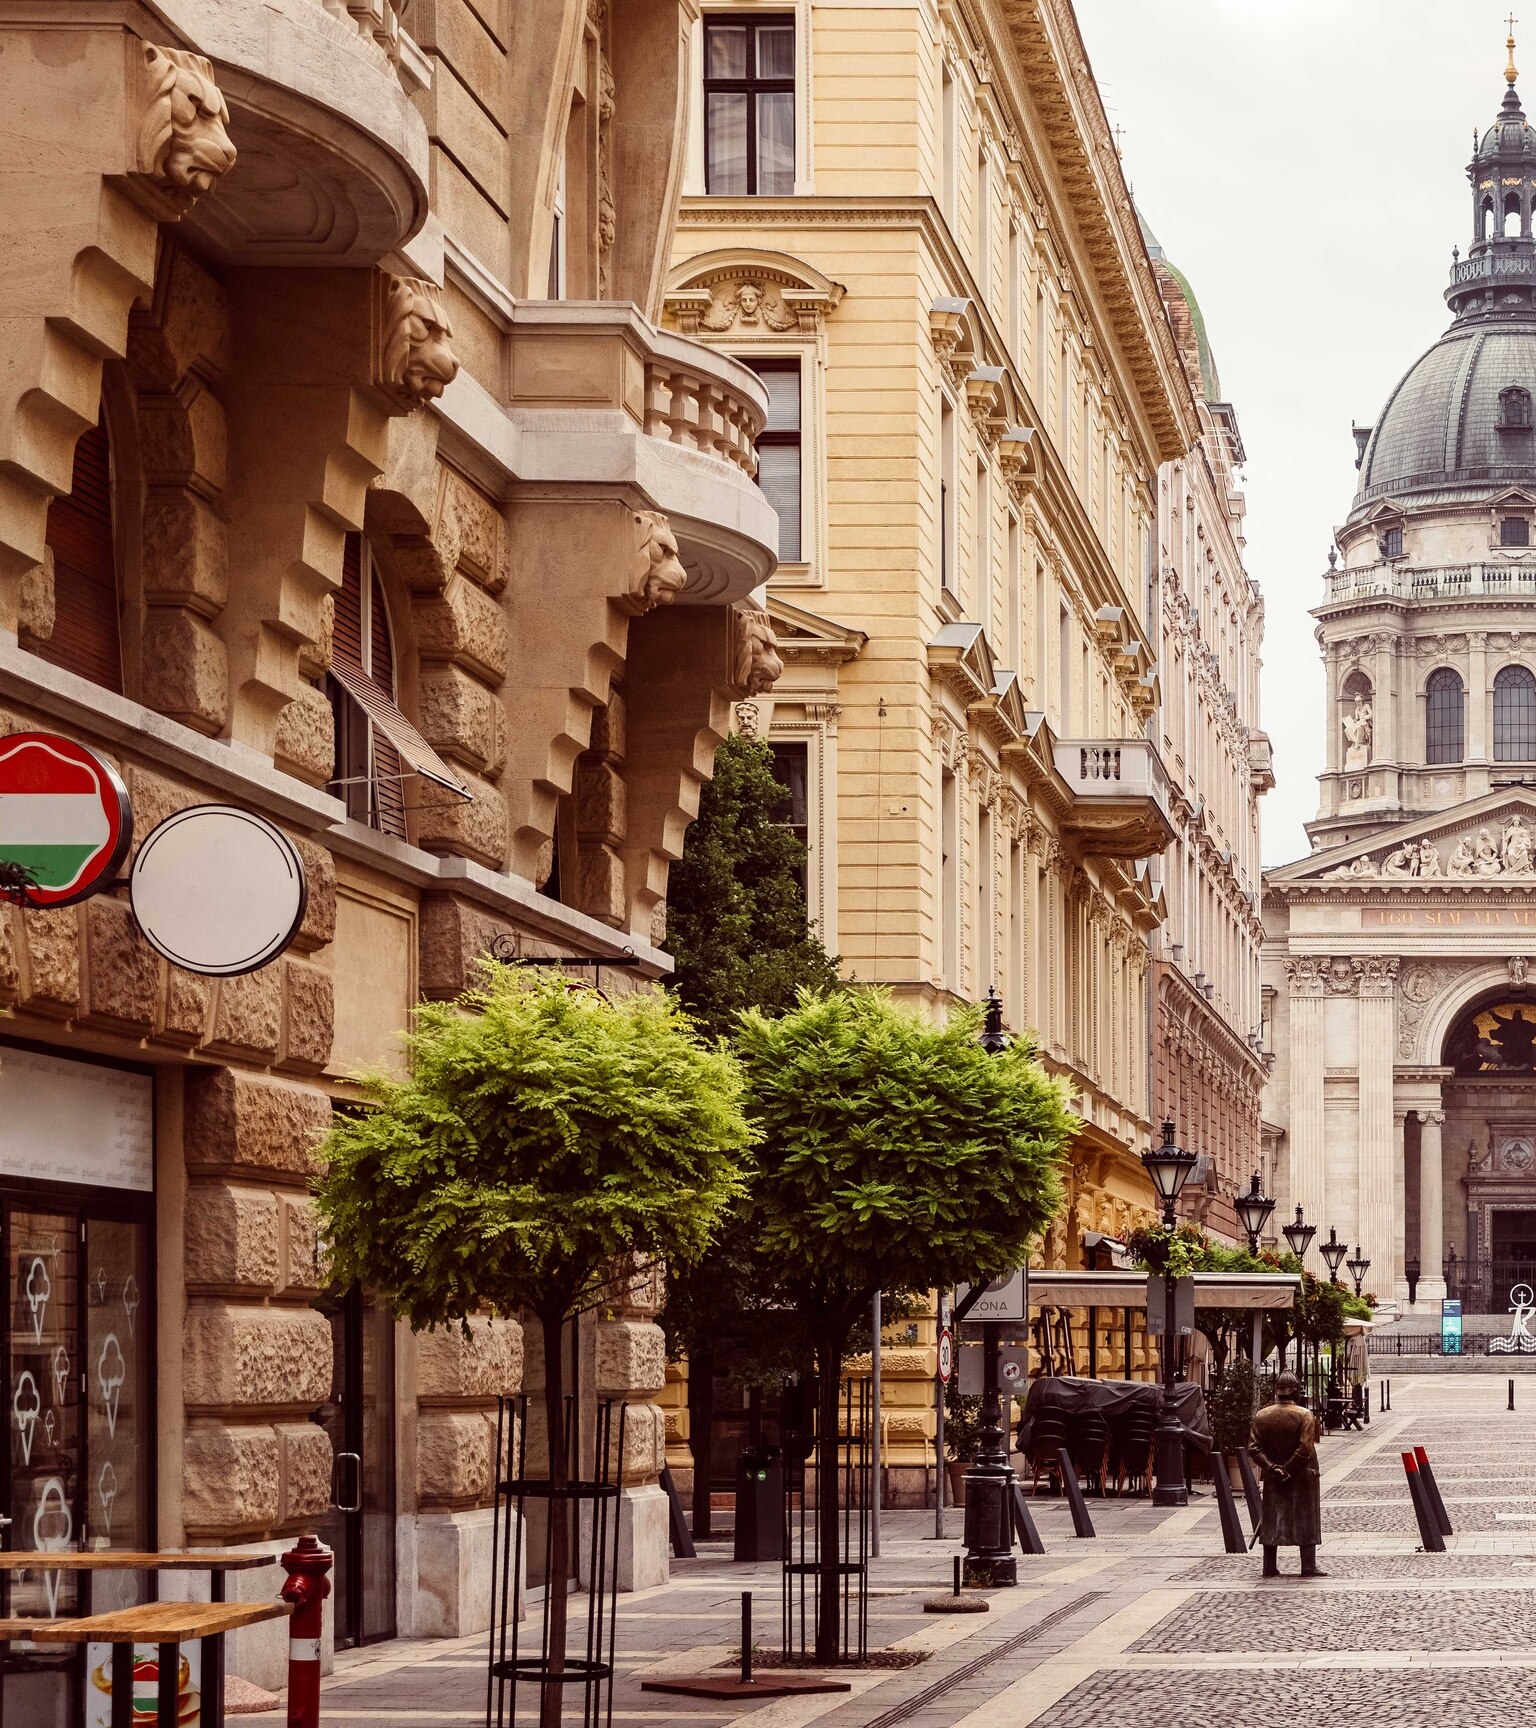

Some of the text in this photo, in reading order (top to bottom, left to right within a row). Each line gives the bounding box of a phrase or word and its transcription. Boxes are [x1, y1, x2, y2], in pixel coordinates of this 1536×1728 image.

[1379, 912, 1413, 925] EGO
[1425, 912, 1461, 925] SUM
[1474, 912, 1502, 925] VIA
[971, 1299, 1008, 1311] ZÓNA
[941, 1346, 949, 1366] 30
